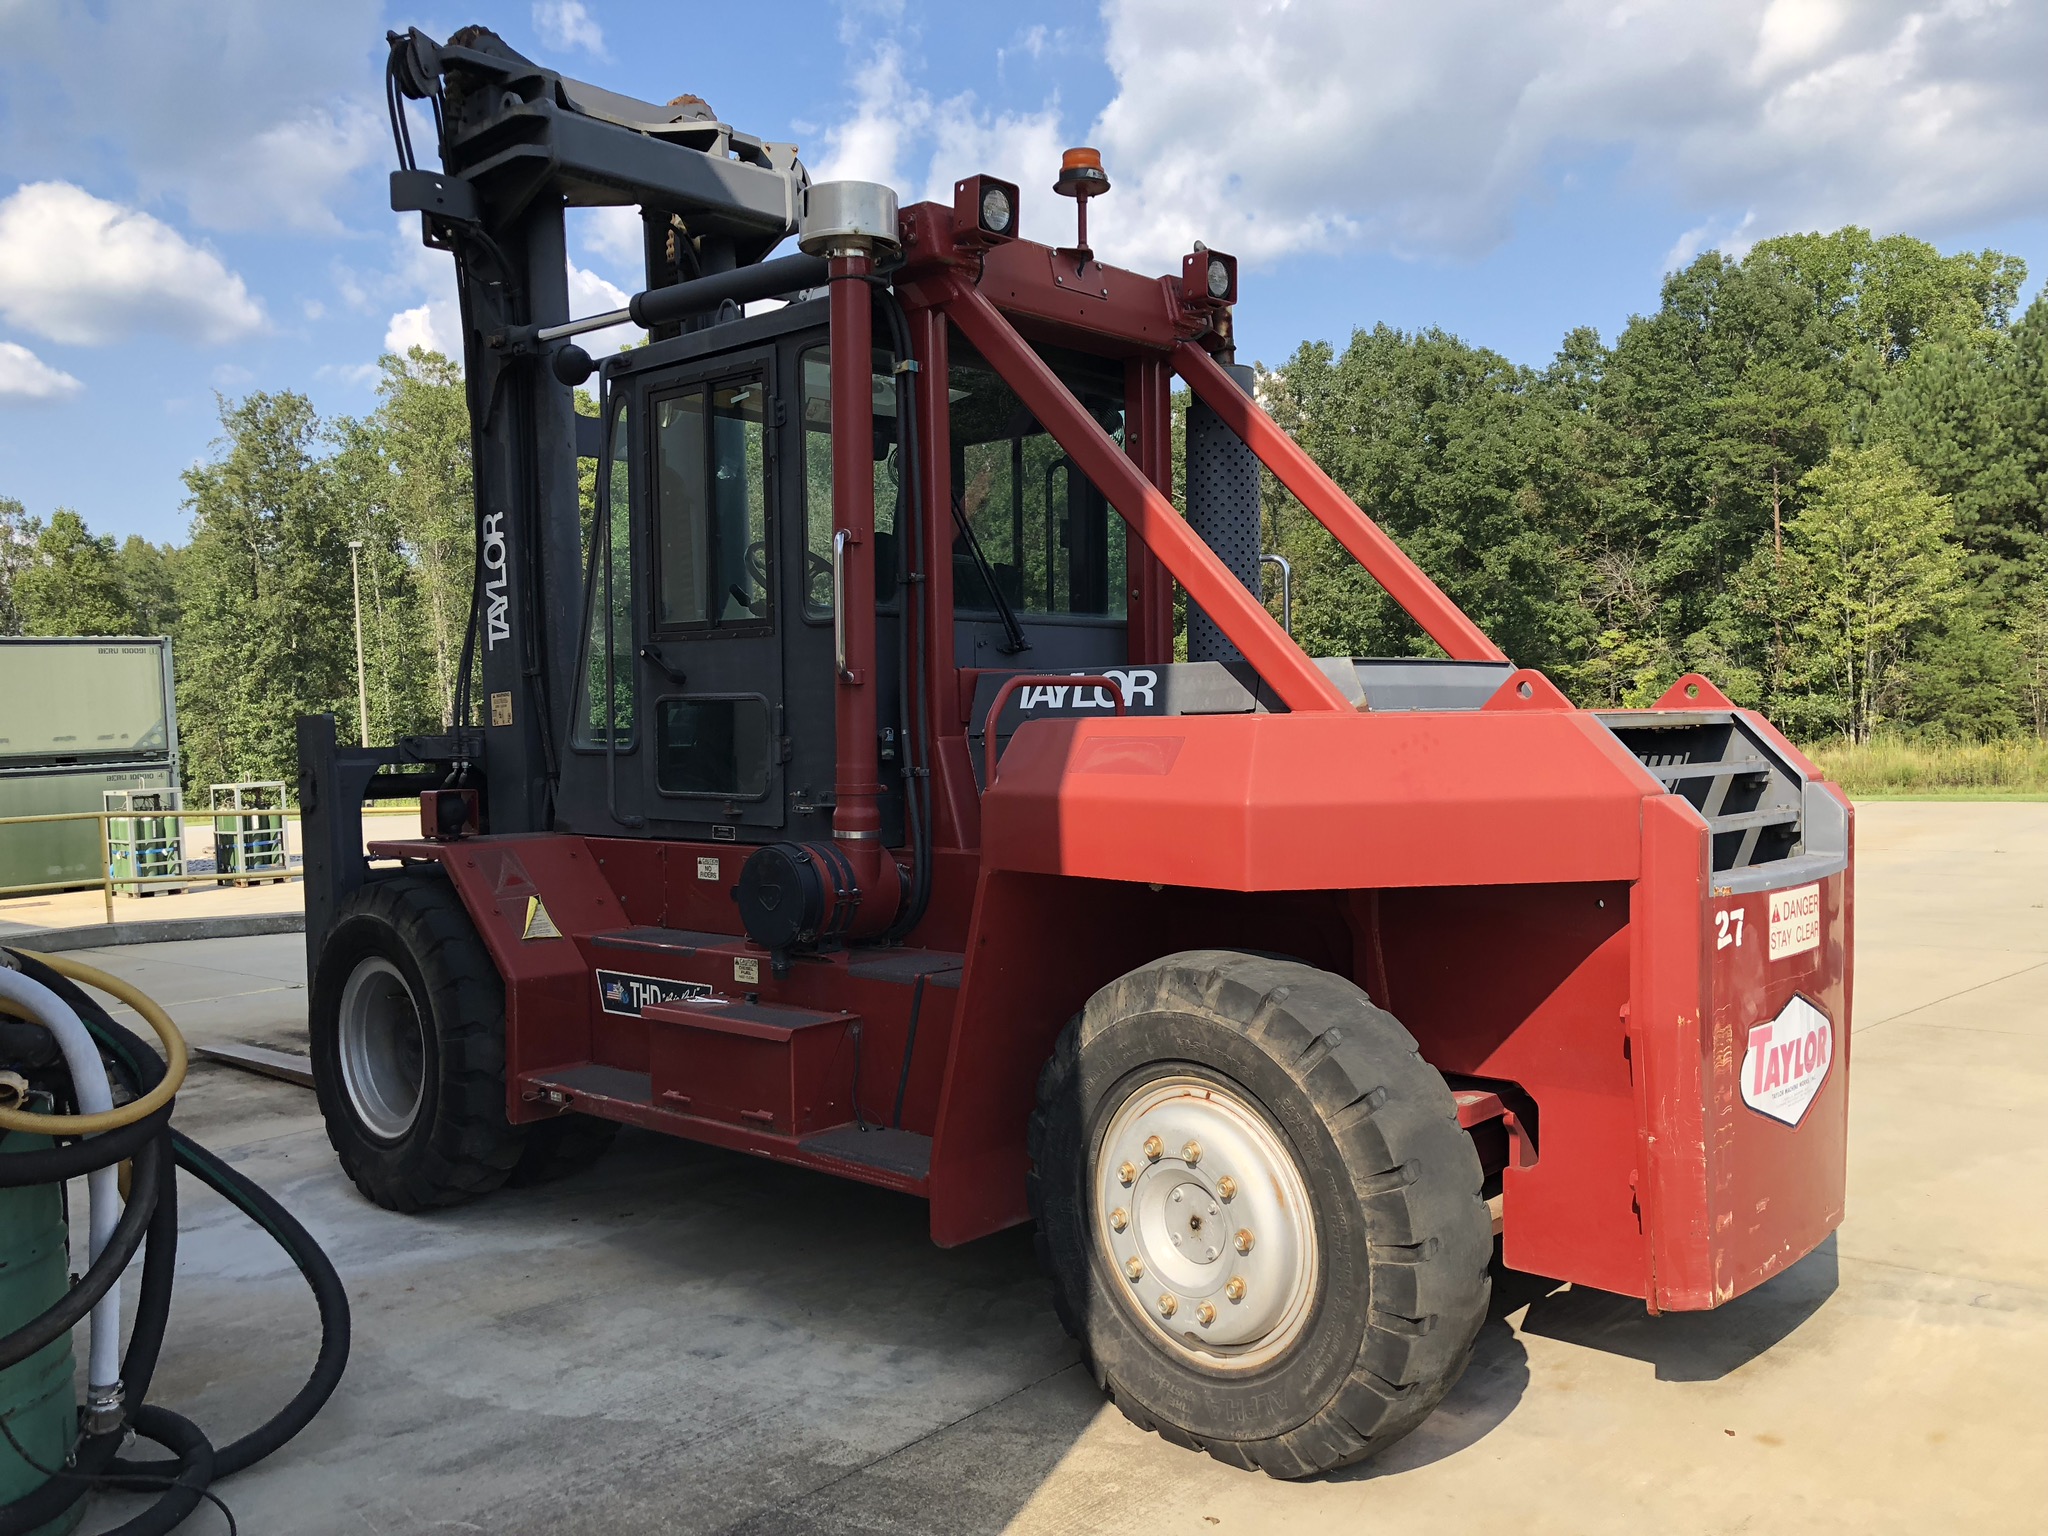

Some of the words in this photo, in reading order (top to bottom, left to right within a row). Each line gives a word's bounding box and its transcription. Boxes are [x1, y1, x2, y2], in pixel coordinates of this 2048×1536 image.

[482, 512, 510, 651] TAYLOR
[700, 871, 717, 879] RIDERS
[1783, 894, 1819, 920] DANGER
[1715, 908, 1745, 950] 27
[1771, 928, 1792, 951] STAY
[1796, 920, 1819, 944] CLEAR
[629, 981, 662, 1009] THD
[1749, 1025, 1828, 1097] TAYLOR
[1203, 1387, 1292, 1423] ALPHA
